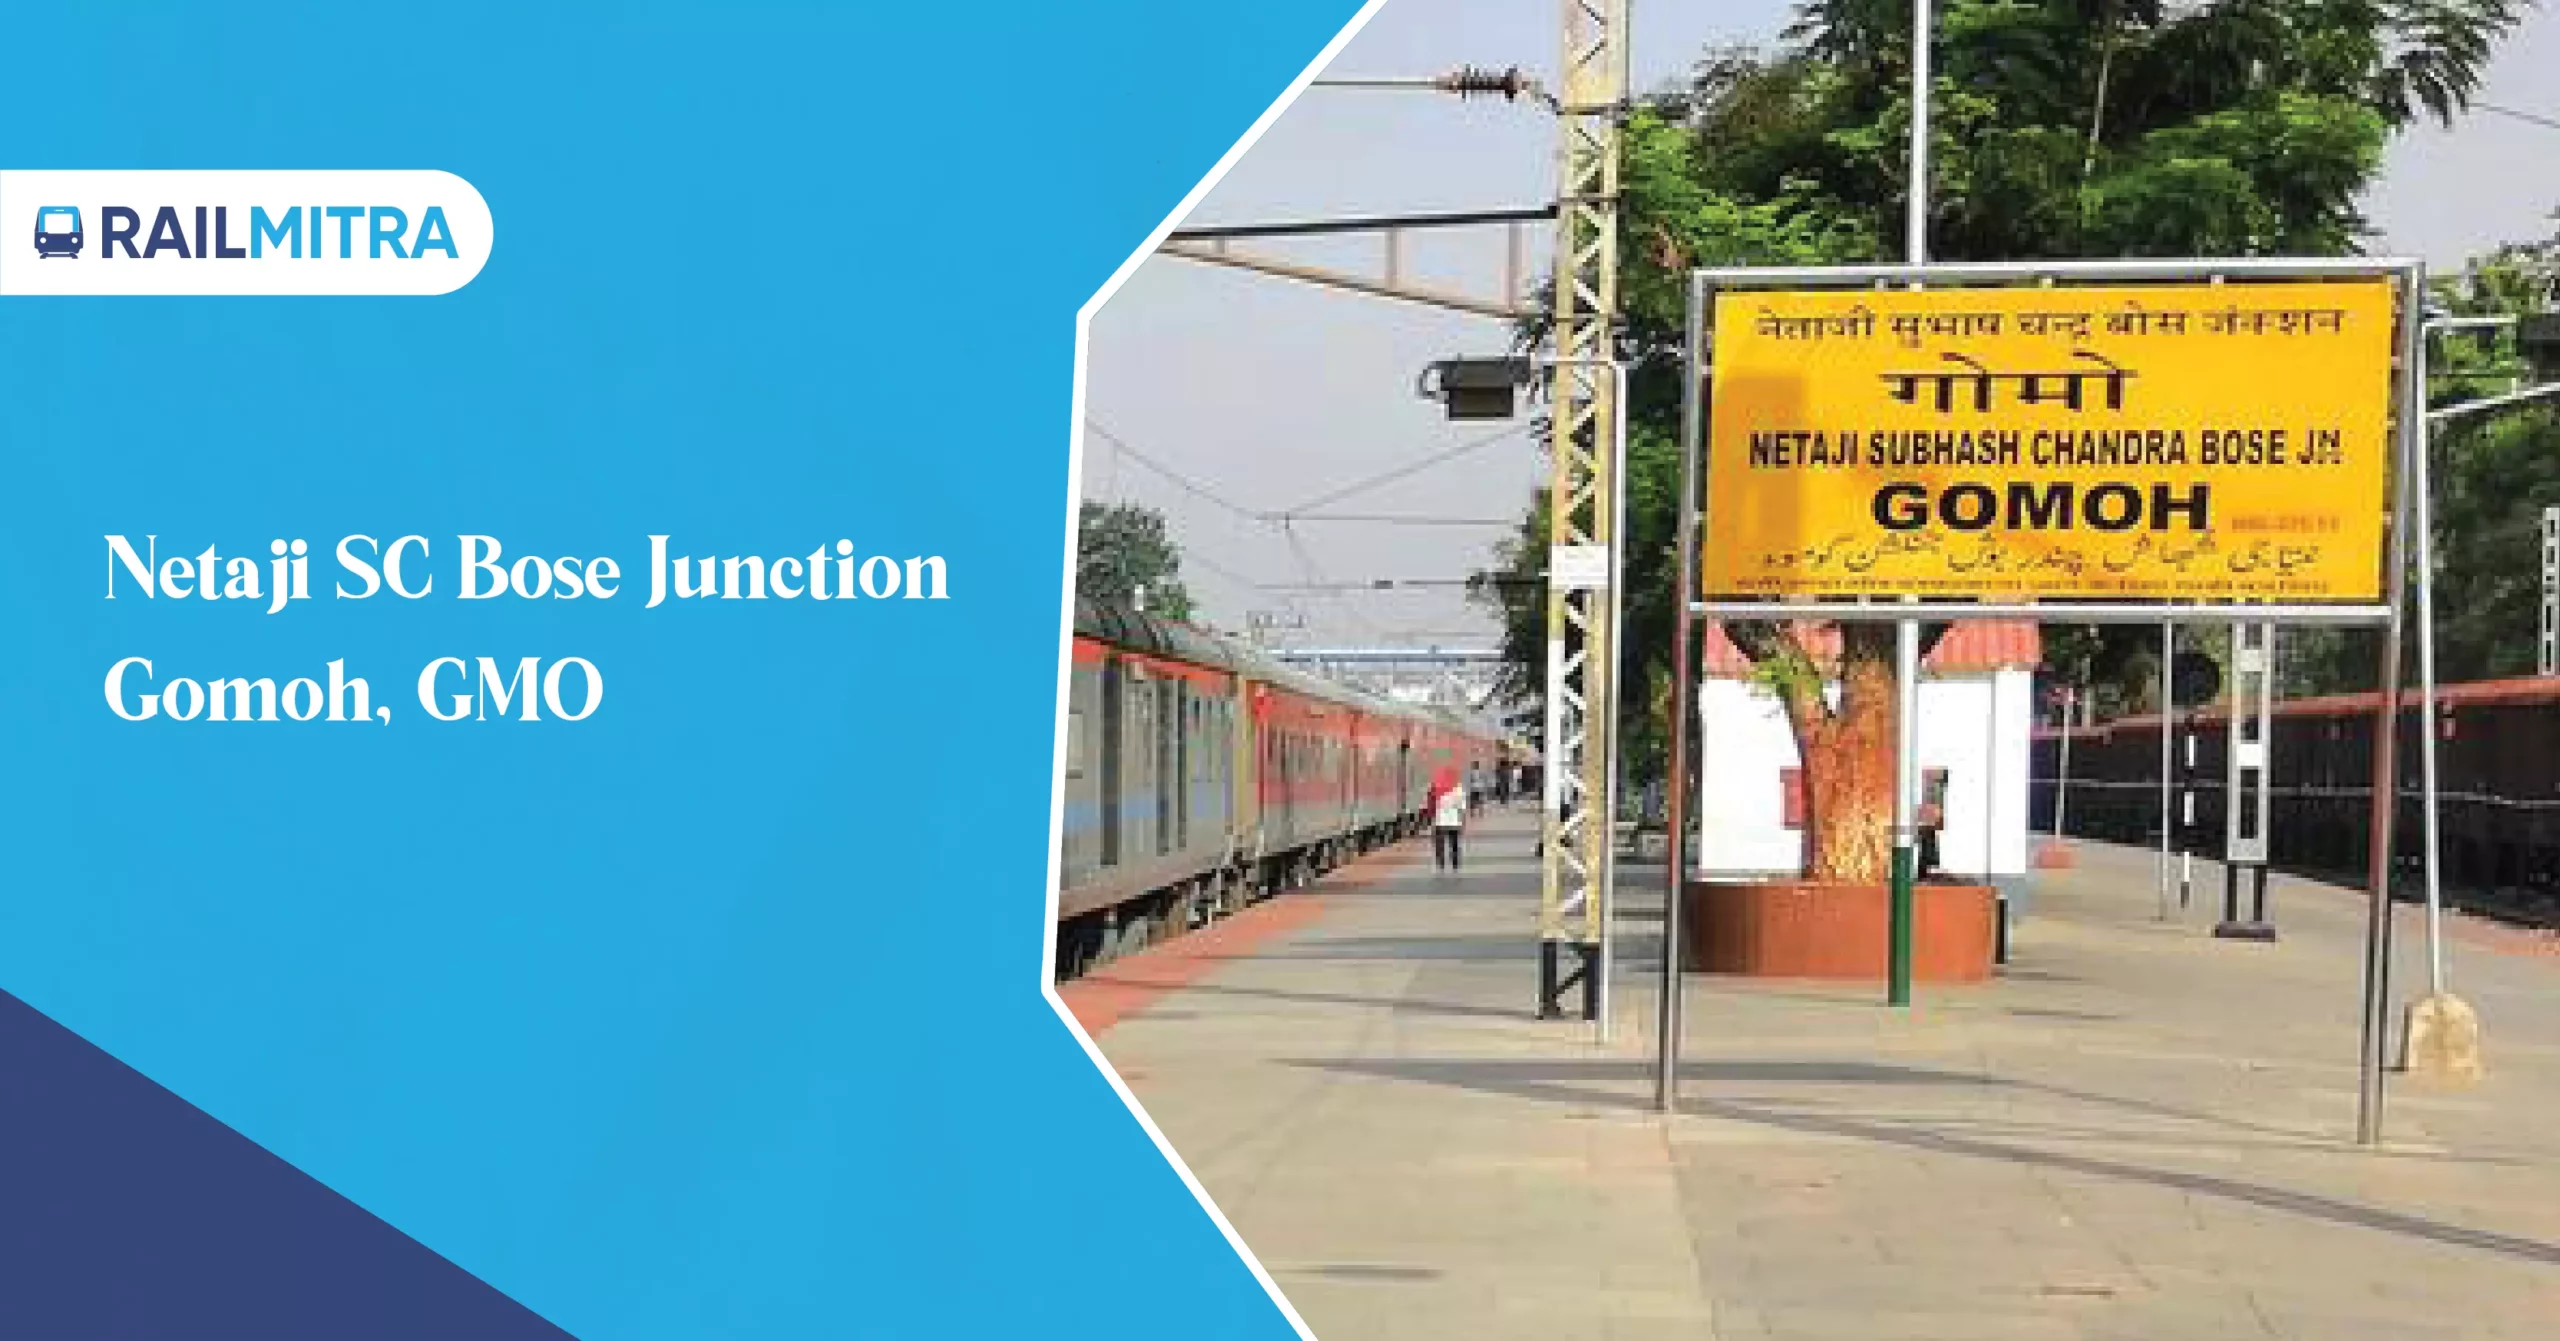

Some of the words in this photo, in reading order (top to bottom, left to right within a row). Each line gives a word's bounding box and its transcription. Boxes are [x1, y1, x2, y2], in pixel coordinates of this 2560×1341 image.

[1756, 303, 1876, 340] नेताजी
[1888, 311, 2004, 348] सुभाष
[2103, 299, 2187, 336] बोस
[1878, 351, 2138, 414] गोमो
[1749, 430, 1858, 468] NETAJI
[1870, 430, 2018, 465] SUBHASH
[2032, 430, 2187, 466] CHANDRA
[2201, 430, 2285, 465] BOSE
[1871, 480, 2211, 531] GOMOH
